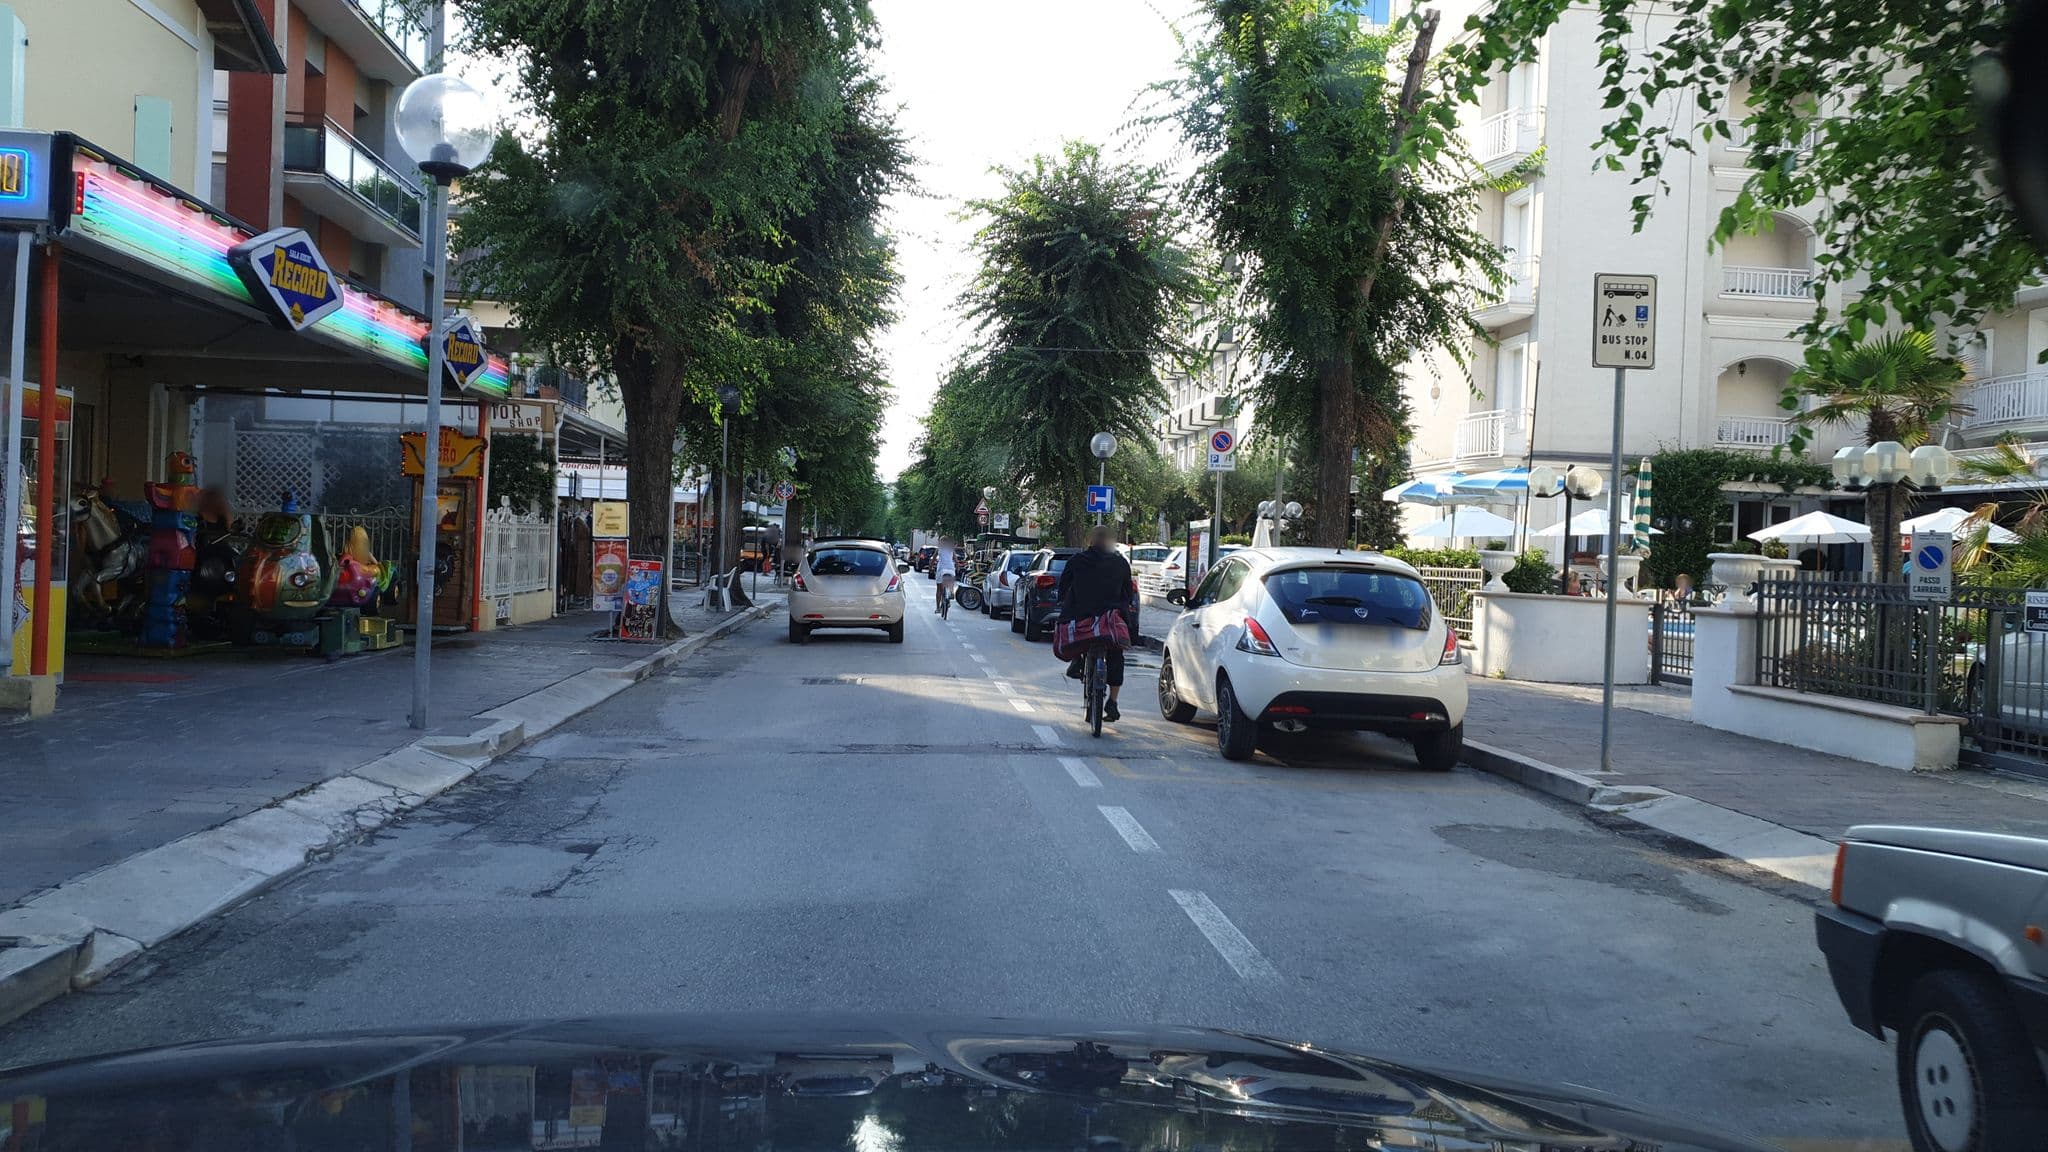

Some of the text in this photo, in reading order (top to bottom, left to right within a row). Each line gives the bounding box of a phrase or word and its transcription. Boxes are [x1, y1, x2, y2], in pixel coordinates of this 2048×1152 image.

[271, 247, 328, 299] RECORD
[1601, 334, 1648, 346] BUS STOP
[1624, 349, 1647, 360] N.04
[509, 416, 541, 428] SHOP
[1919, 576, 1941, 585] PASSO
